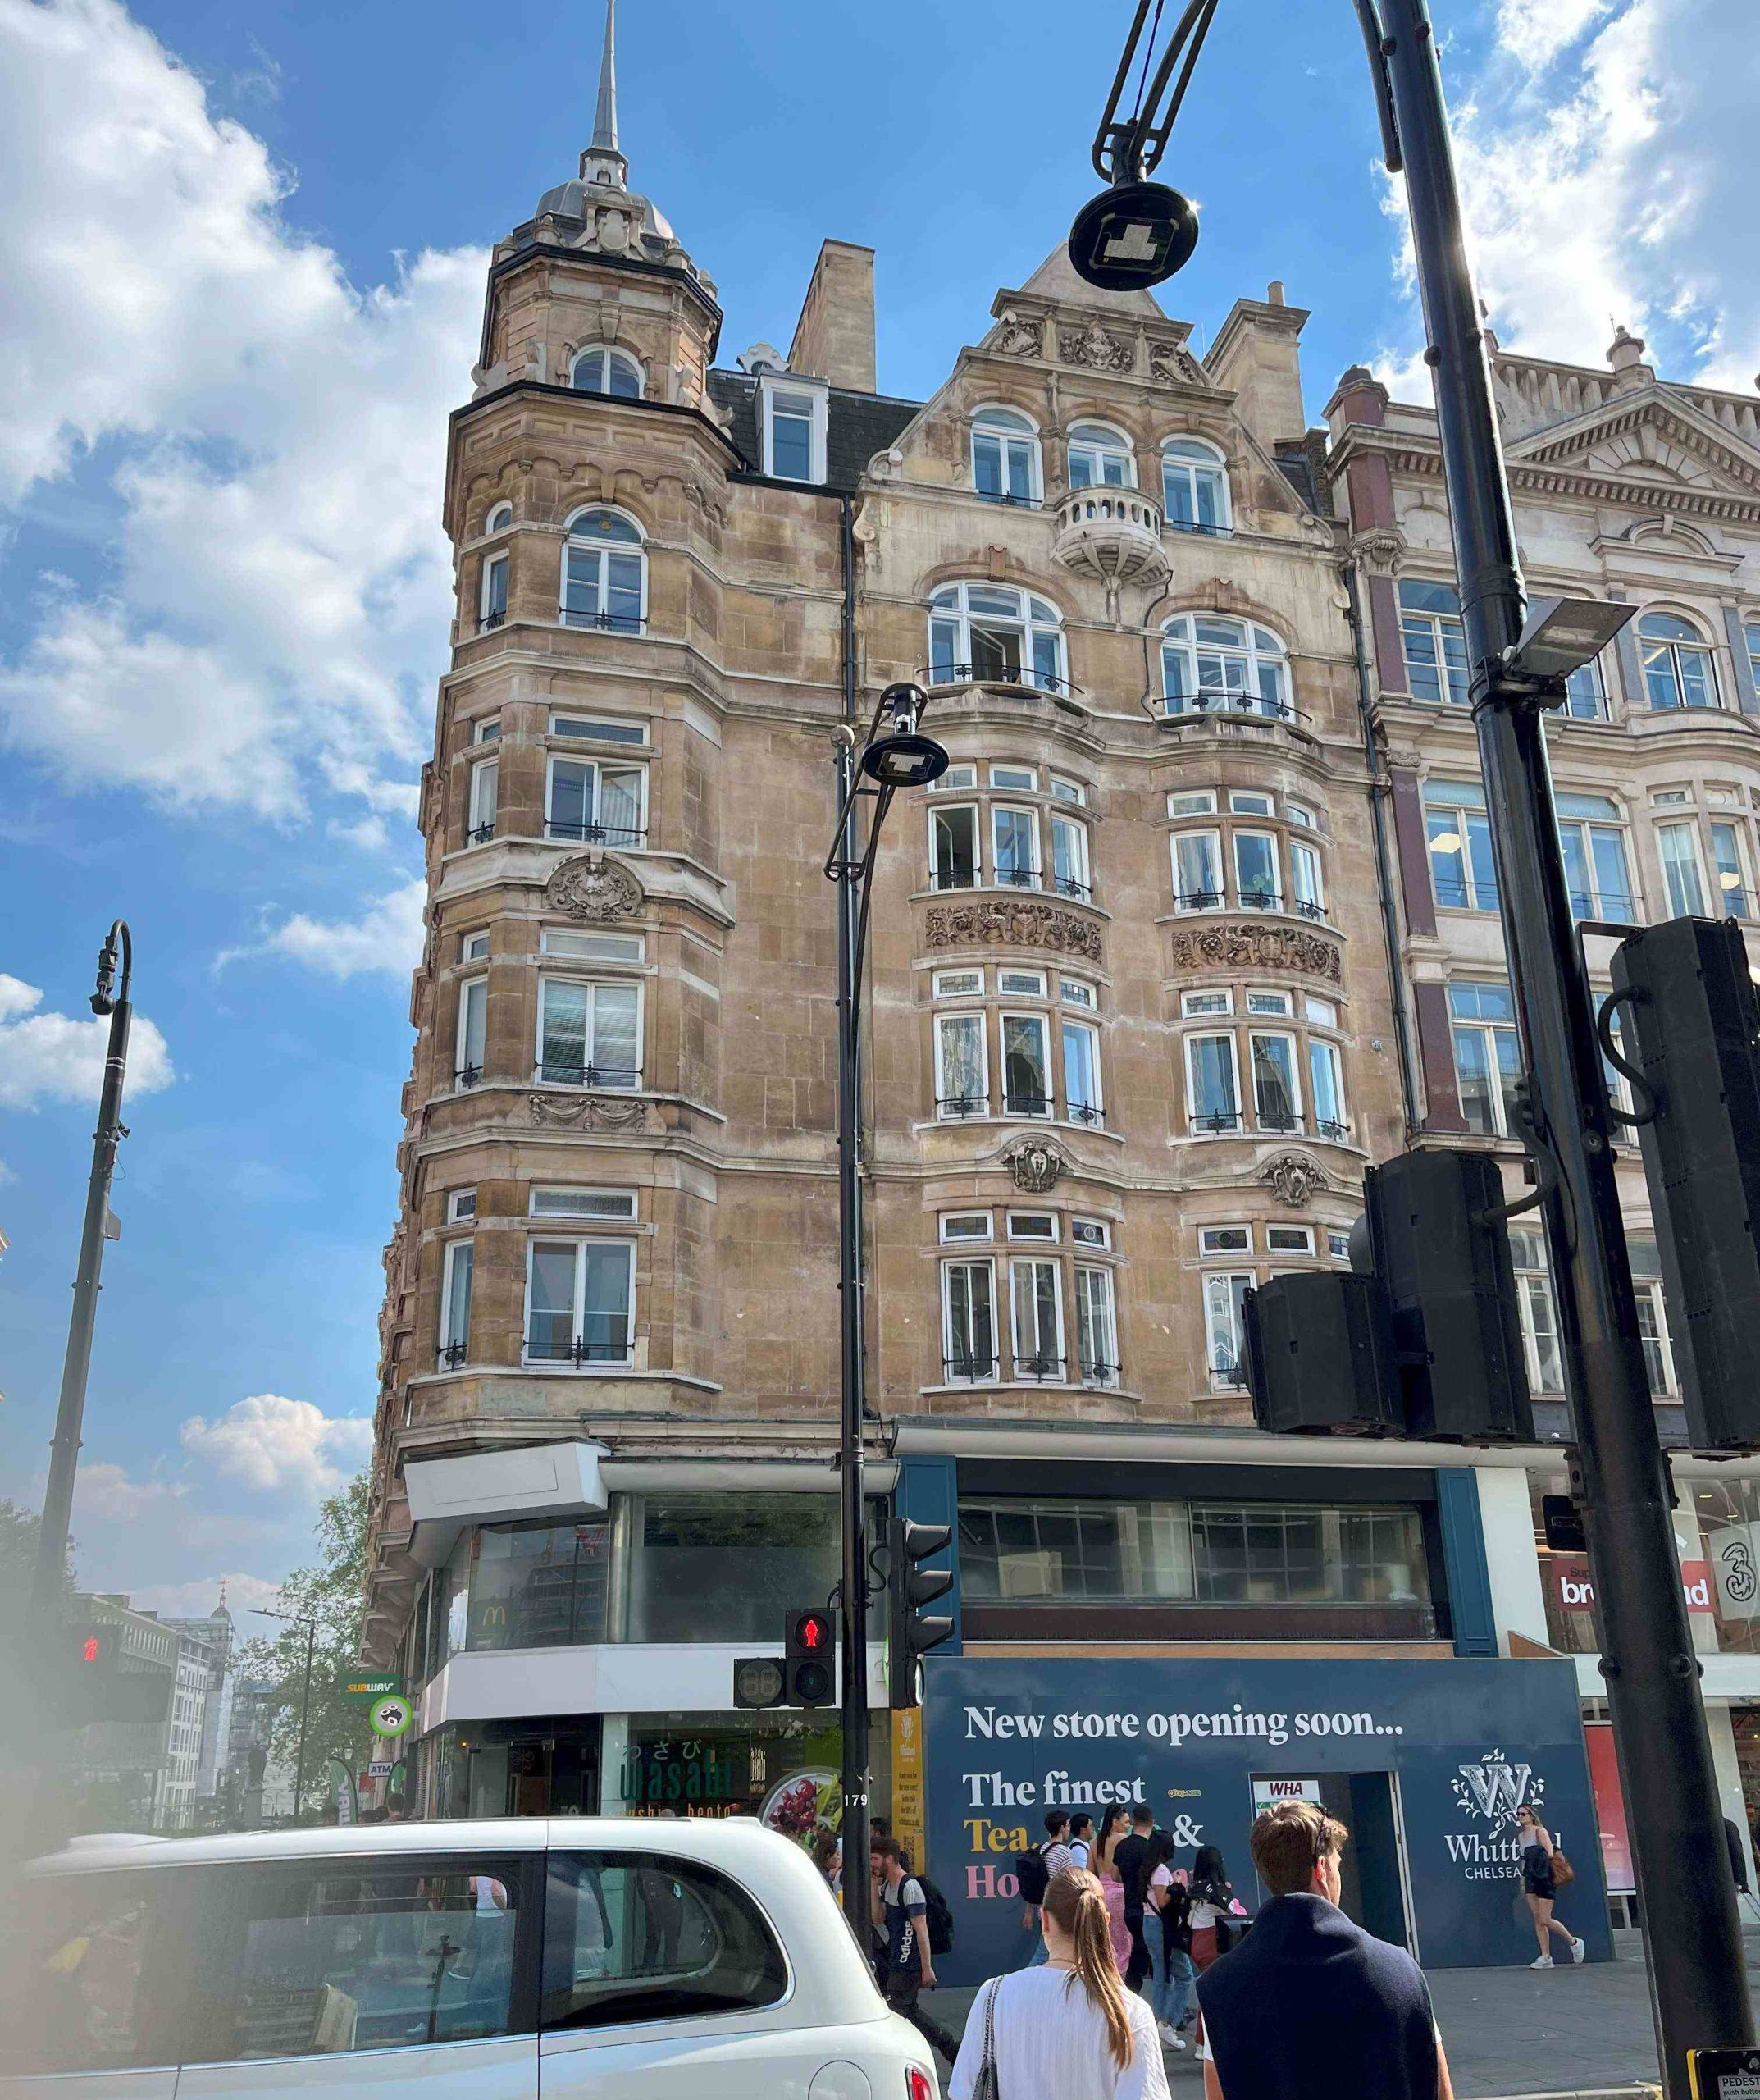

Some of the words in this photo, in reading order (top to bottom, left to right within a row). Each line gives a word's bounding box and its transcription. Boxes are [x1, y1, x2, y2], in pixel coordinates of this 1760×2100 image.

[345, 1682, 394, 1693] SUBWAY
[963, 1706, 1046, 1739] New
[1052, 1711, 1140, 1738] store
[1147, 1703, 1289, 1746] opening
[1294, 1713, 1403, 1736] soon...
[620, 1748, 732, 1801] wasabi
[962, 1771, 1037, 1806] The
[1043, 1770, 1147, 1805] finest
[1270, 1782, 1303, 1796] WHA
[845, 1794, 868, 1806] 179
[688, 1803, 731, 1817] bento
[1464, 1866, 1522, 1879] CHELSEA
[899, 1920, 914, 1963] adidas
